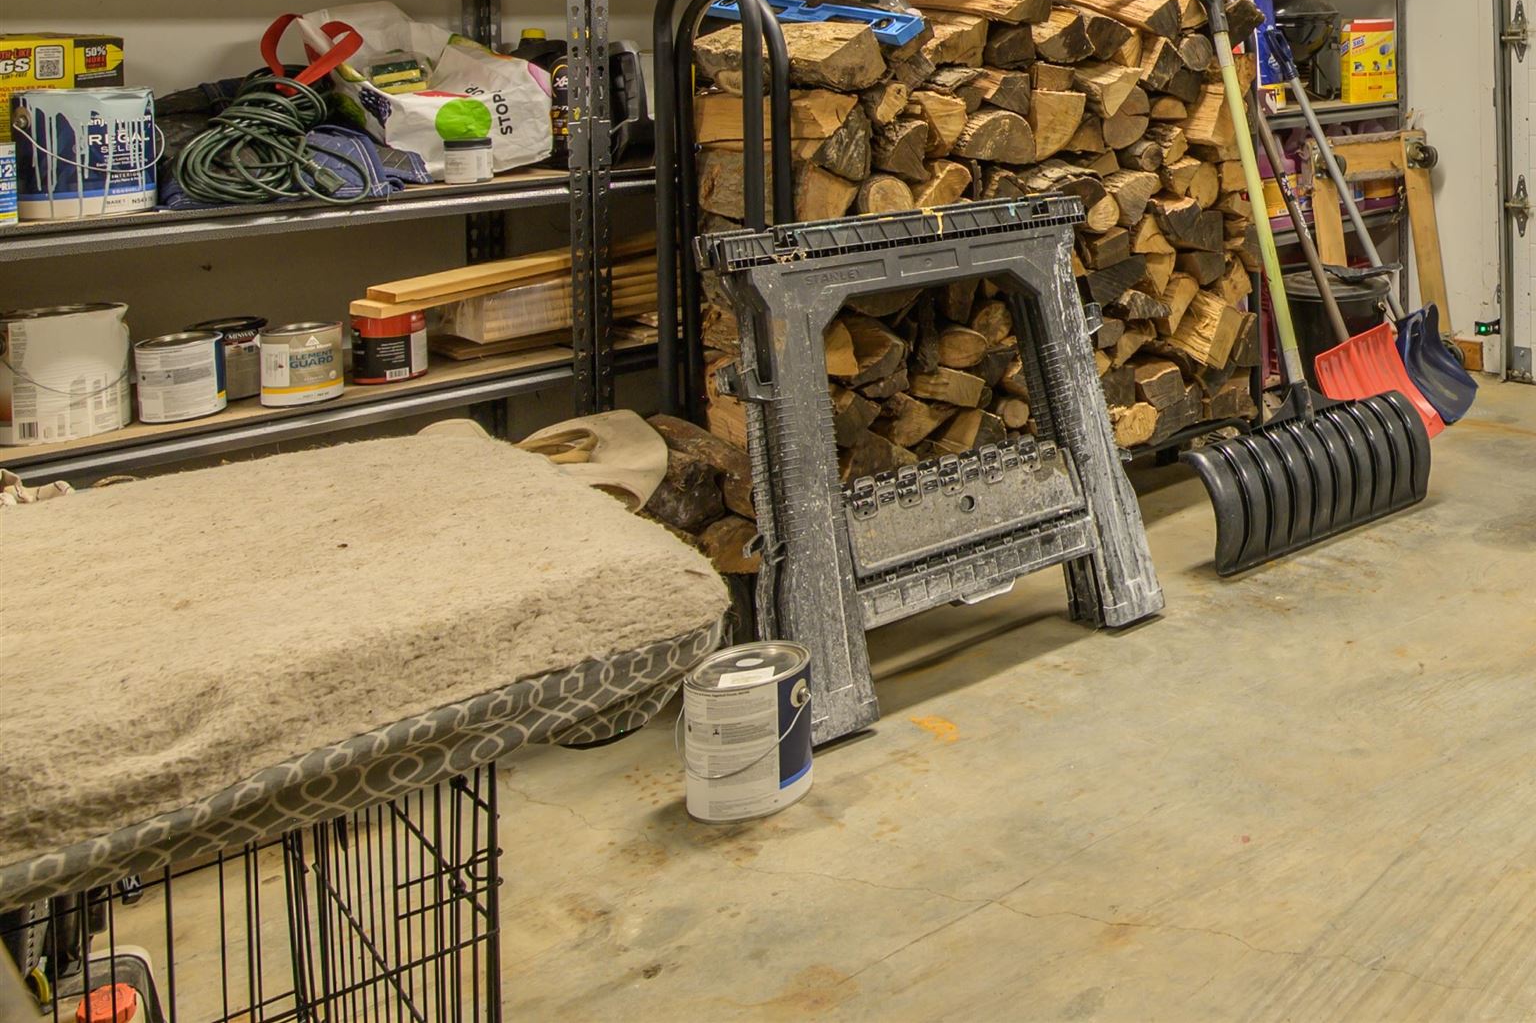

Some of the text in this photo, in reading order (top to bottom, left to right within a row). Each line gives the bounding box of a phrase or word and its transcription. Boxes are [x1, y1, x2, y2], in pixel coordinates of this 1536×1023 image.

[85, 45, 107, 57] 50%
[805, 268, 860, 286] STANLEY
[289, 349, 333, 361] ELEMENT
[289, 356, 334, 369] GUARD
